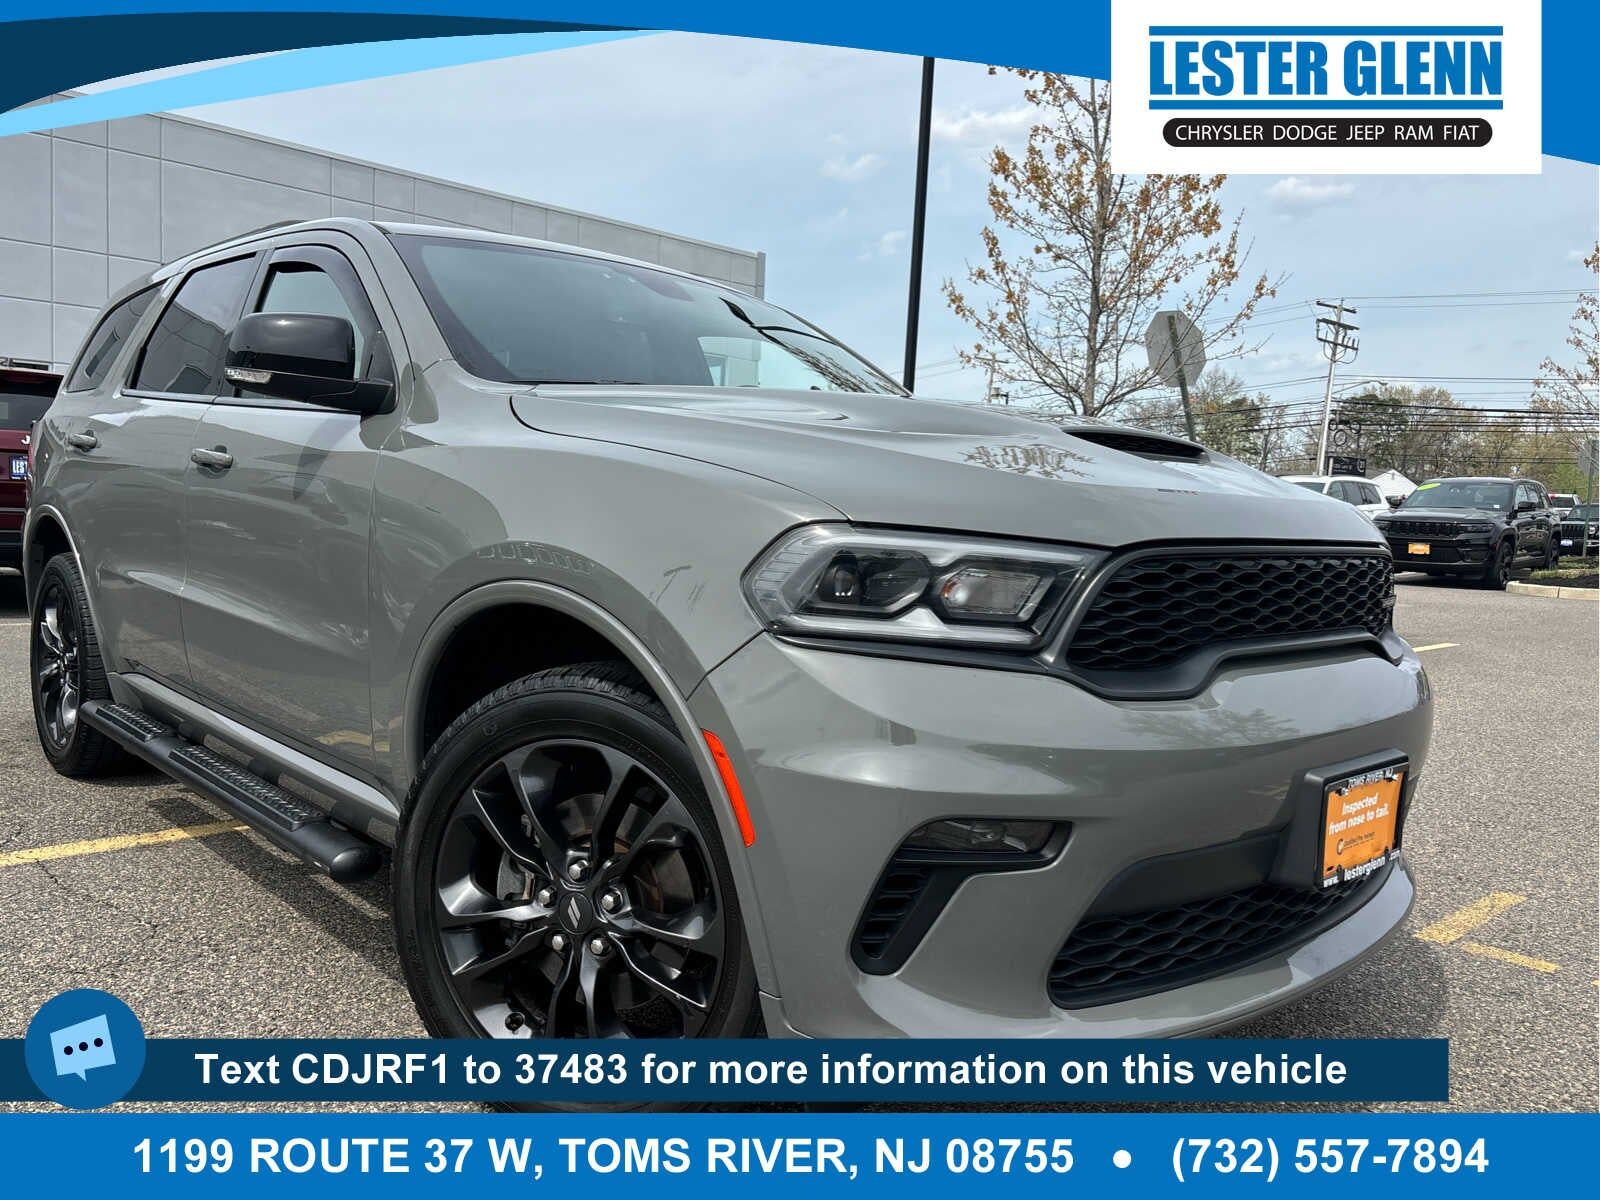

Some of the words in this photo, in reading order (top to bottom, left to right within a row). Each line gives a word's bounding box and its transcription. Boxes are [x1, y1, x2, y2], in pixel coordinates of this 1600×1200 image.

[1343, 794, 1378, 815] Inspected
[1329, 821, 1346, 835] from
[1347, 815, 1365, 828] nose
[1366, 810, 1375, 820] to
[1344, 857, 1385, 880] lesterglenn
